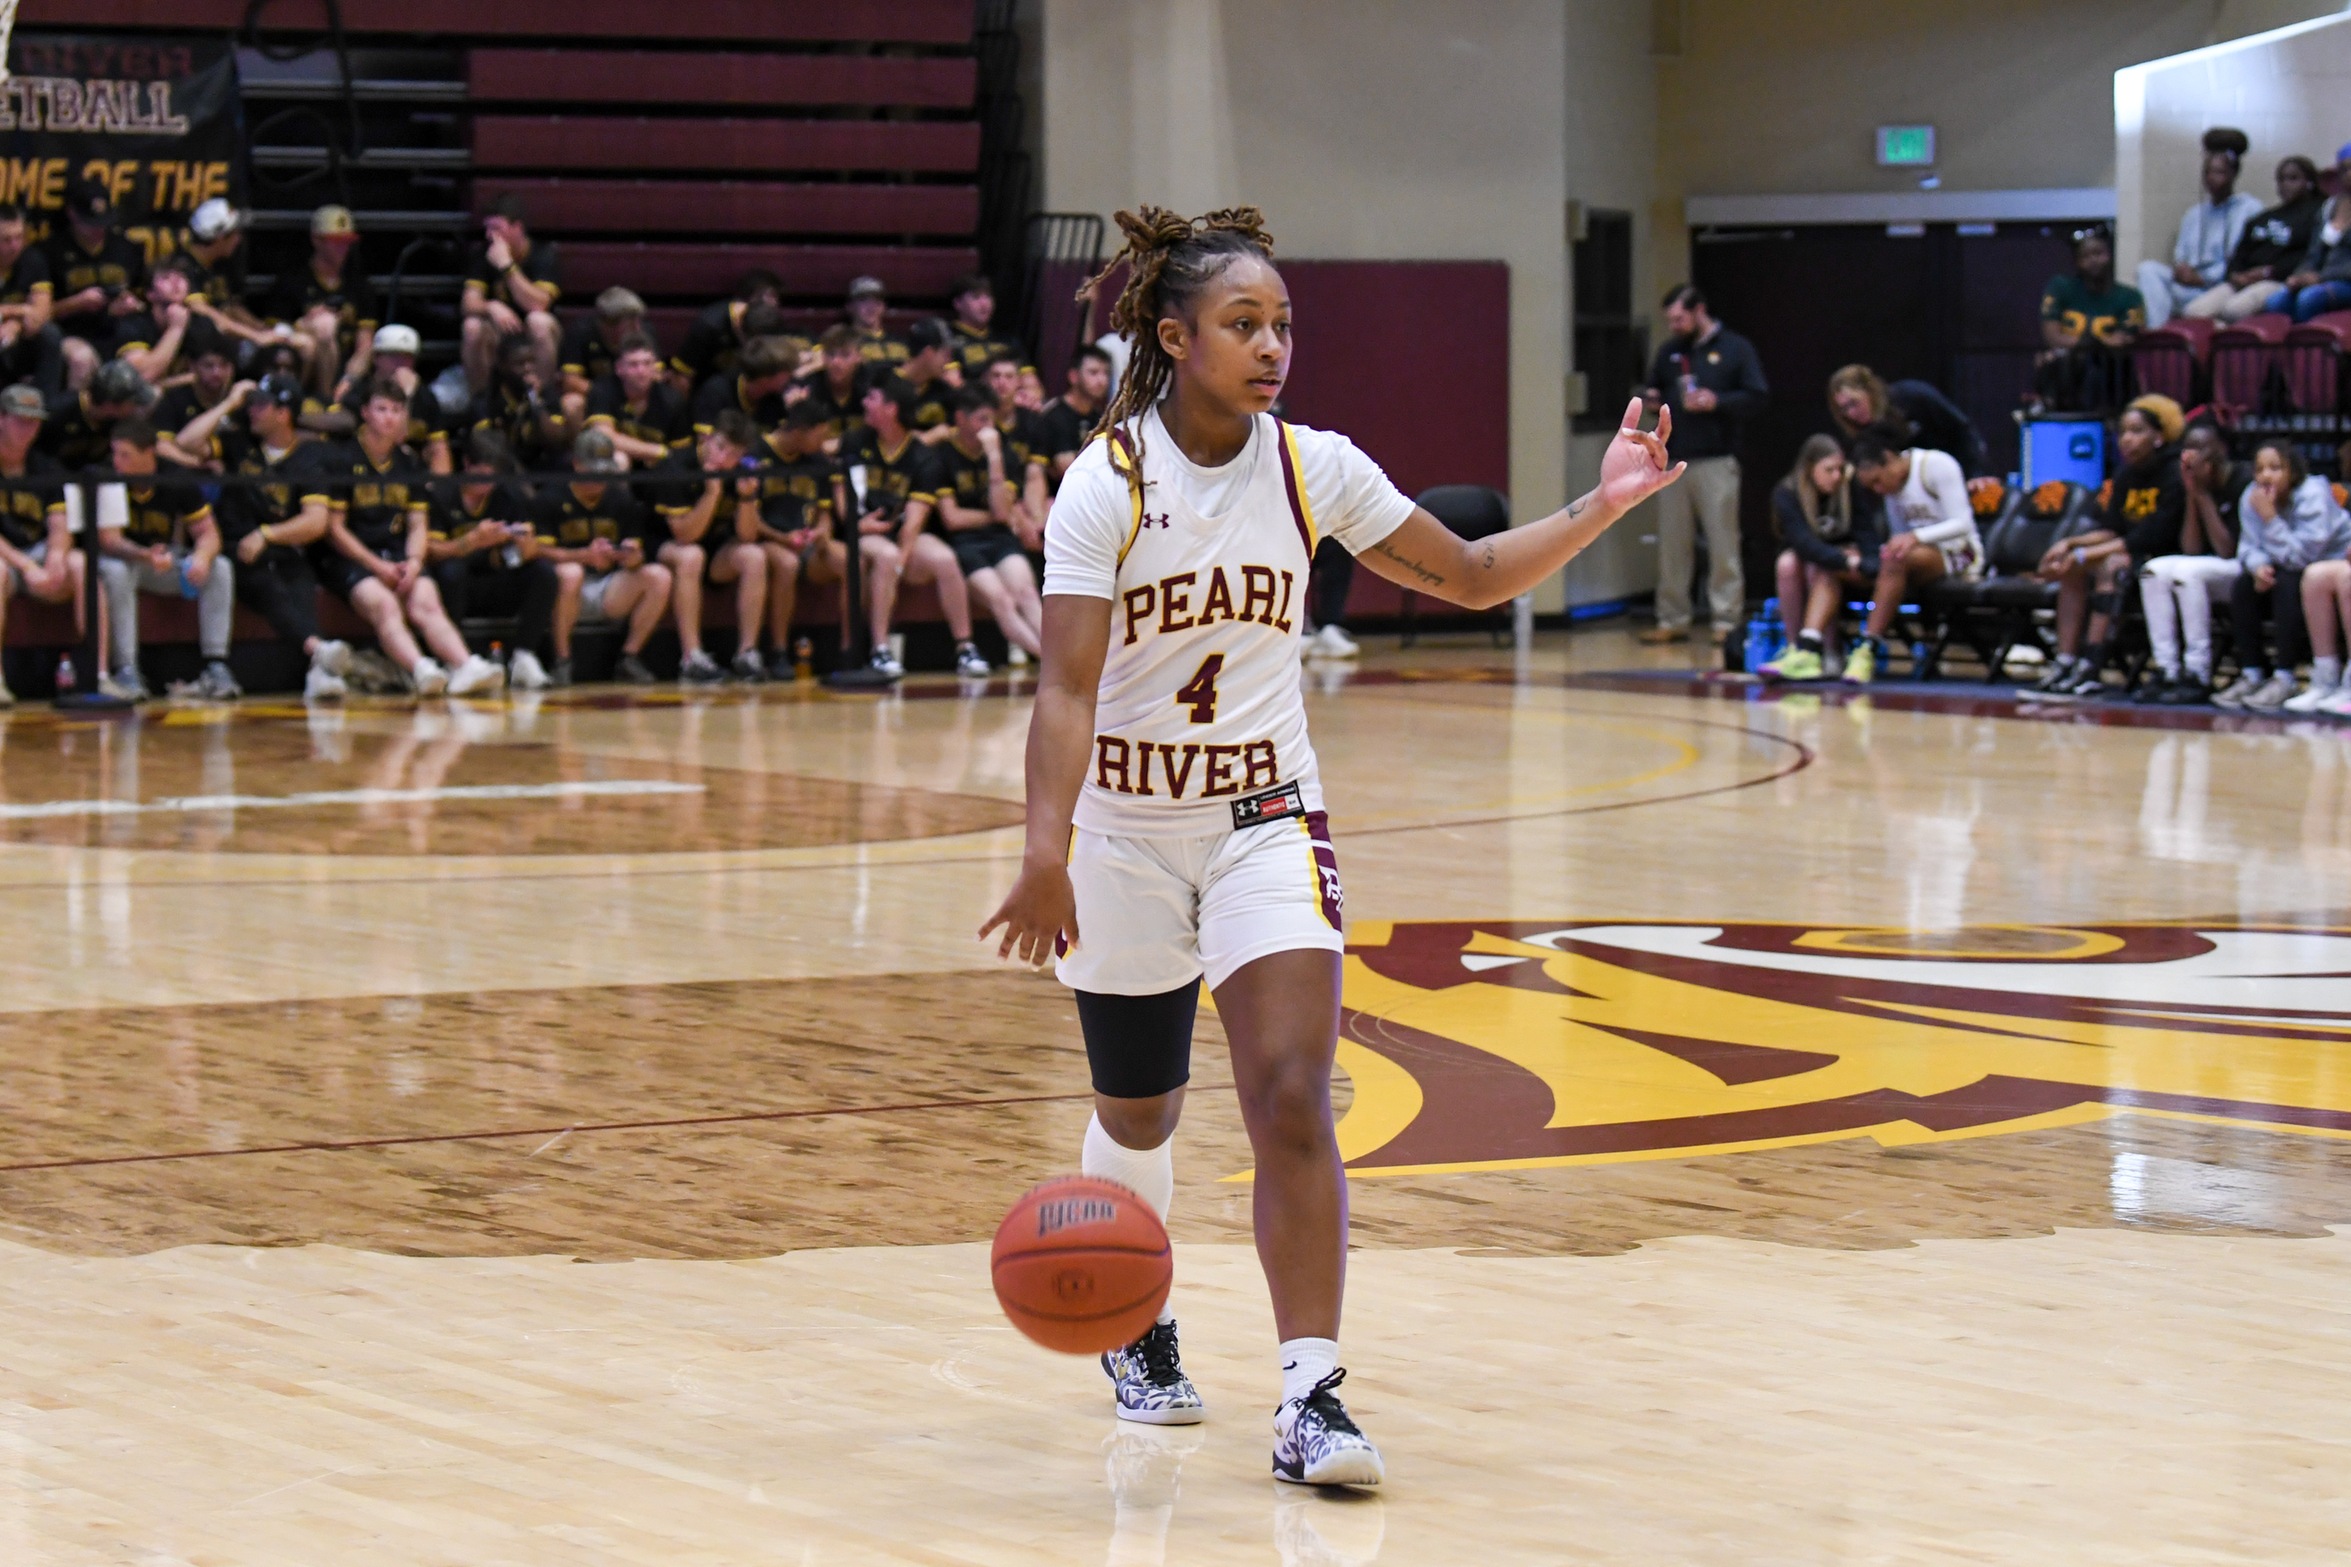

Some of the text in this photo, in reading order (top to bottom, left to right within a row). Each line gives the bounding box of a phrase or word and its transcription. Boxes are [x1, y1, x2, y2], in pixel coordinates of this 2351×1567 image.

[150, 160, 229, 210] THE
[1123, 564, 1294, 646] PEARL
[1175, 652, 1226, 725] 4
[1095, 735, 1279, 801] RIVER
